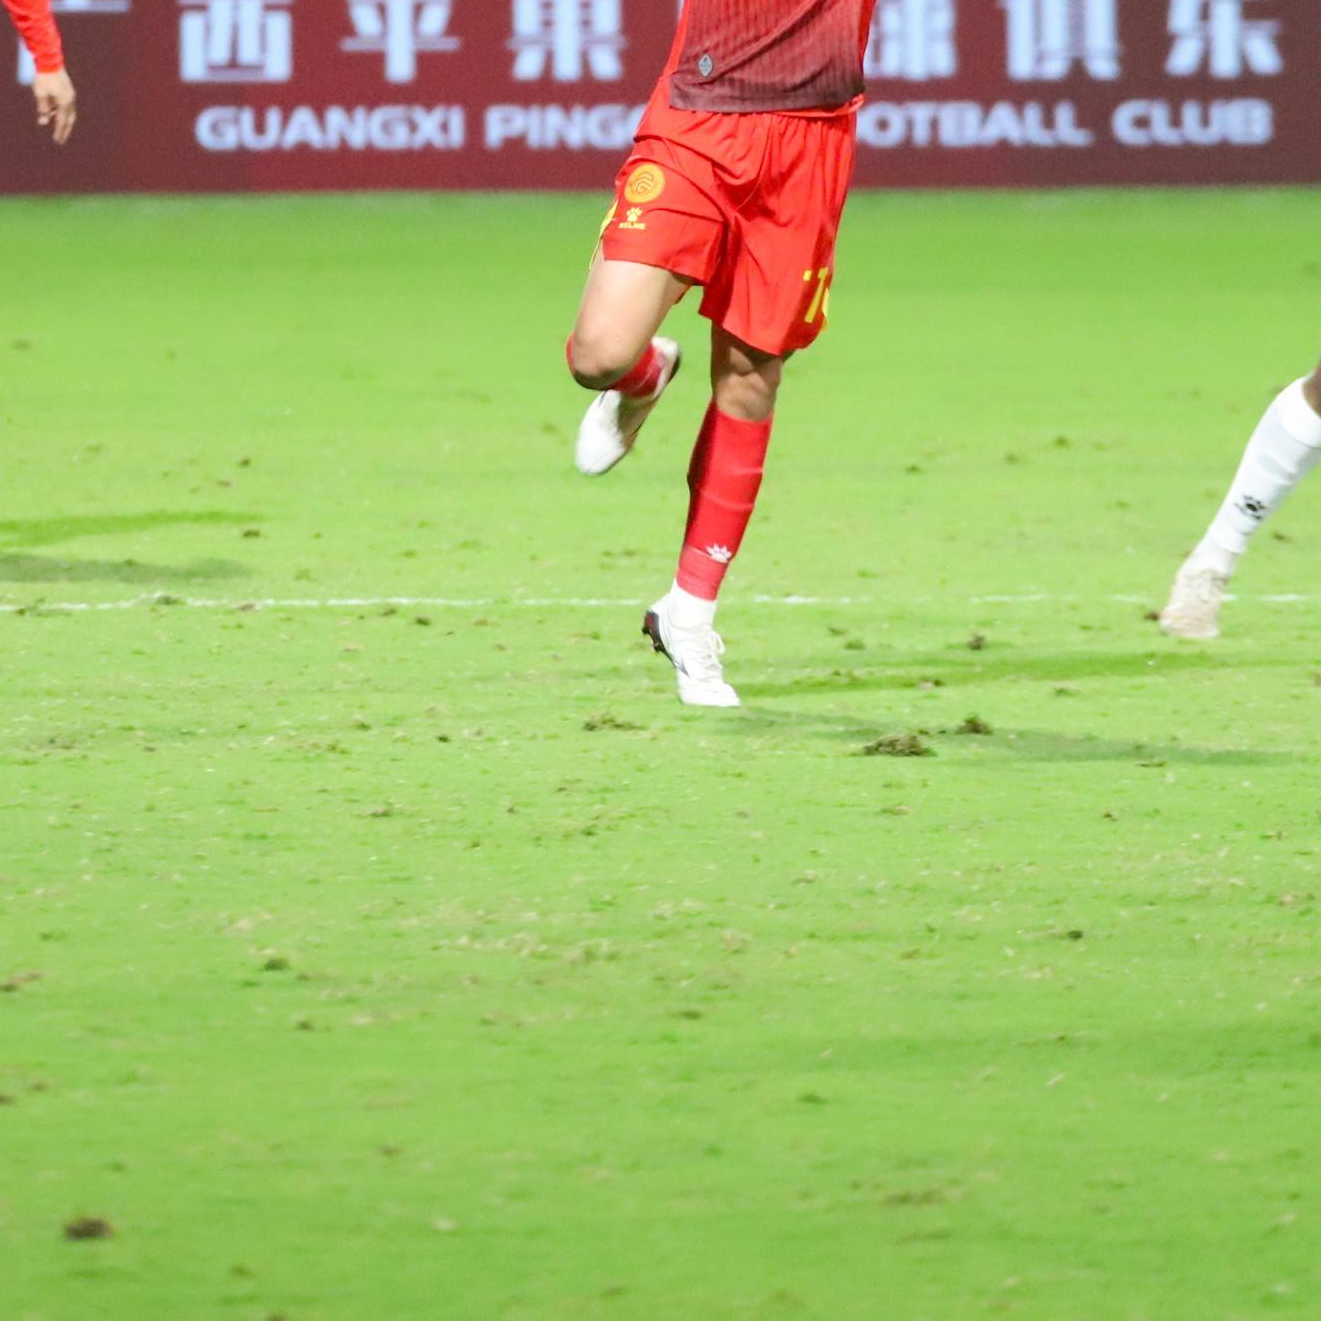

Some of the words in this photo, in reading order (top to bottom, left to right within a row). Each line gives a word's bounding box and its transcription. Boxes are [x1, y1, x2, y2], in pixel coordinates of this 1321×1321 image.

[194, 105, 467, 151] GUANGXI
[485, 104, 645, 151] PING
[857, 101, 1094, 147] OTBALL
[1112, 98, 1275, 146] CLUB
